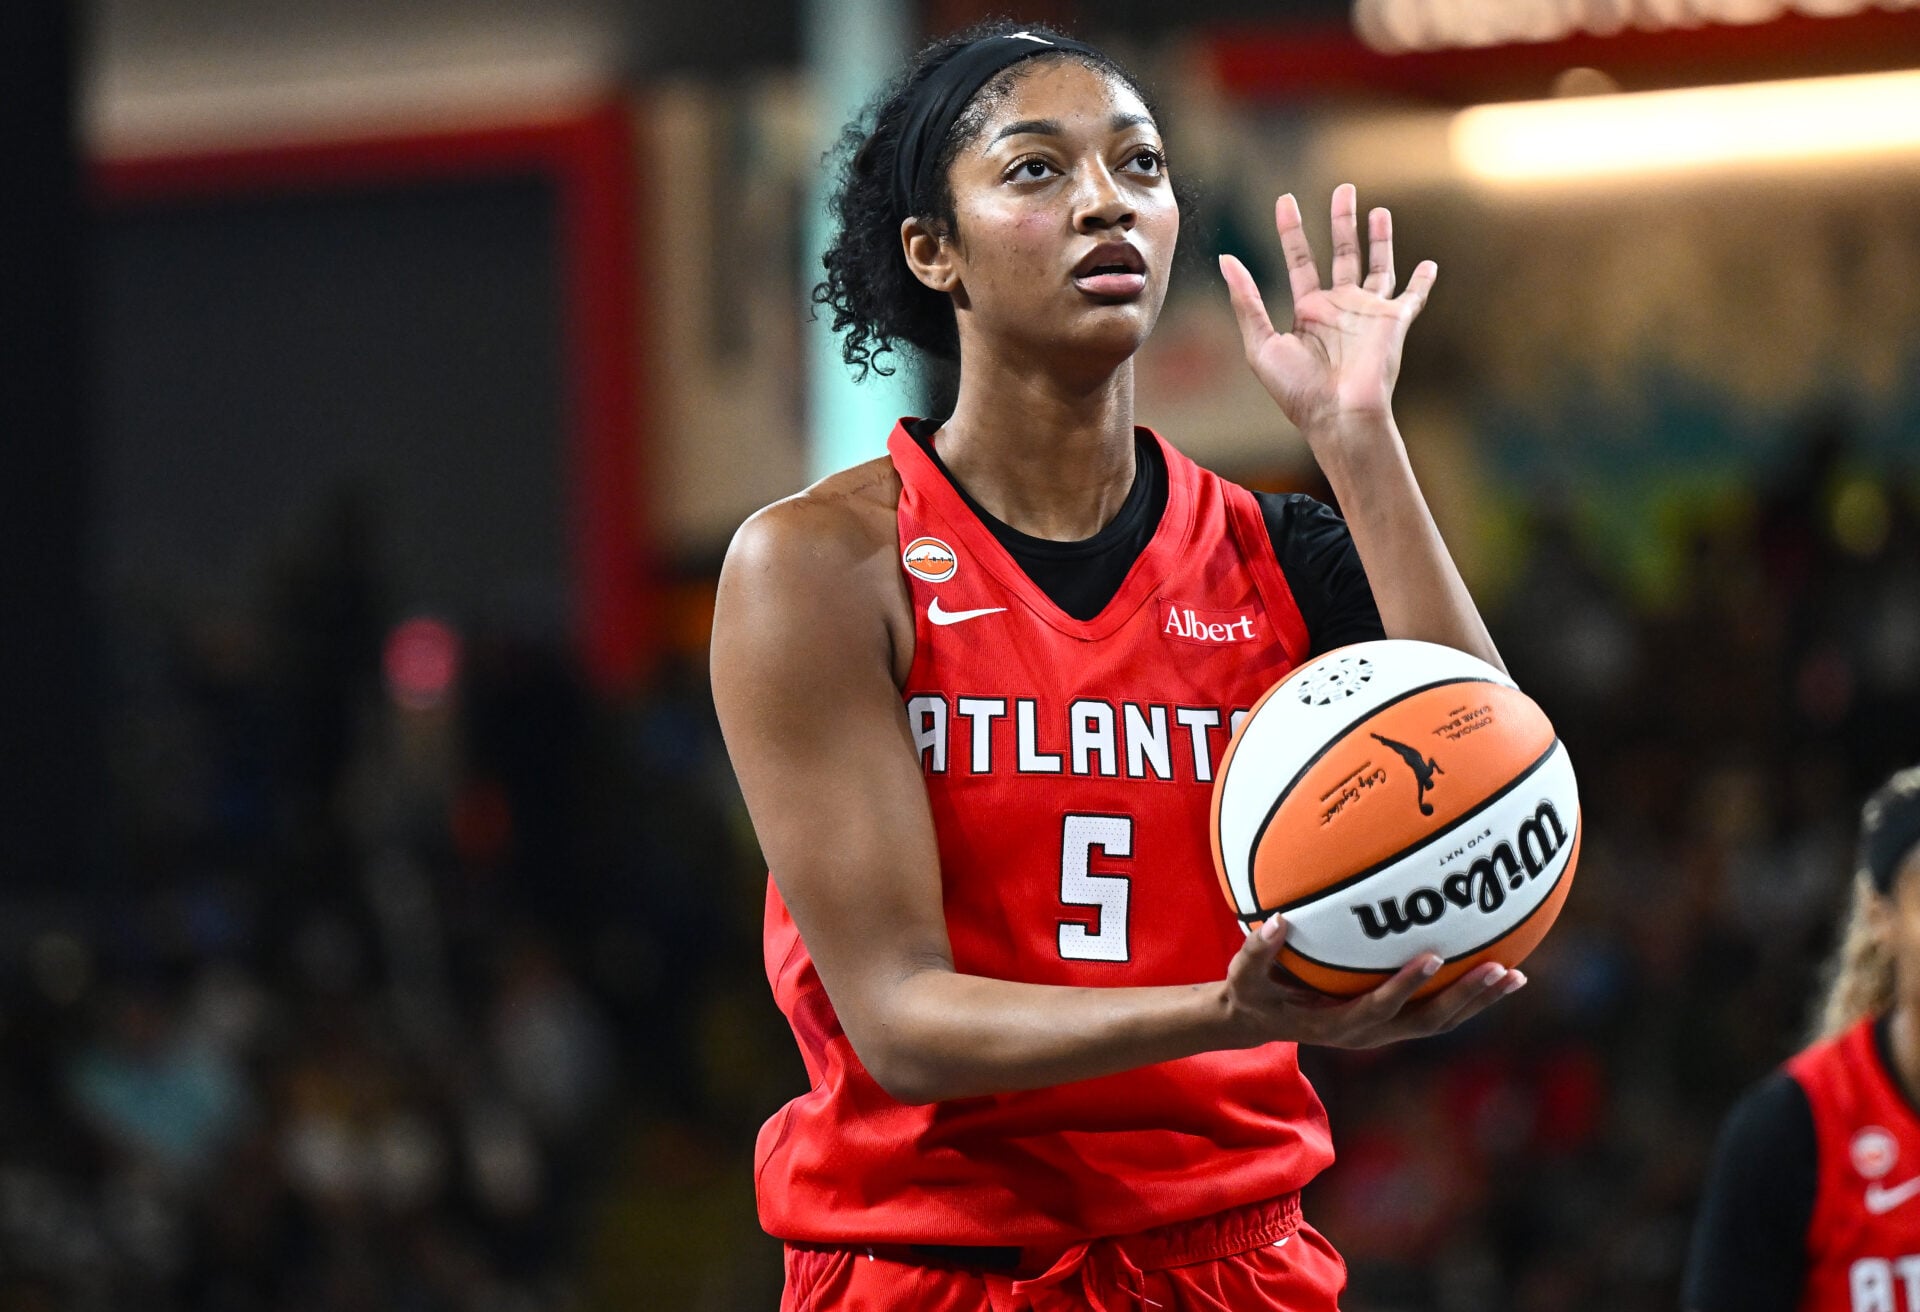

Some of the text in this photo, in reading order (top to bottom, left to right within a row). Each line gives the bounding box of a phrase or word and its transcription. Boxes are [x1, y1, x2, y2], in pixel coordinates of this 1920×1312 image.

[1163, 606, 1256, 642] Albert
[906, 694, 1250, 783] ATLANT
[1057, 813, 1133, 962] 5
[1351, 798, 1568, 940] Wilson
[1439, 828, 1492, 867] EVO NXT
